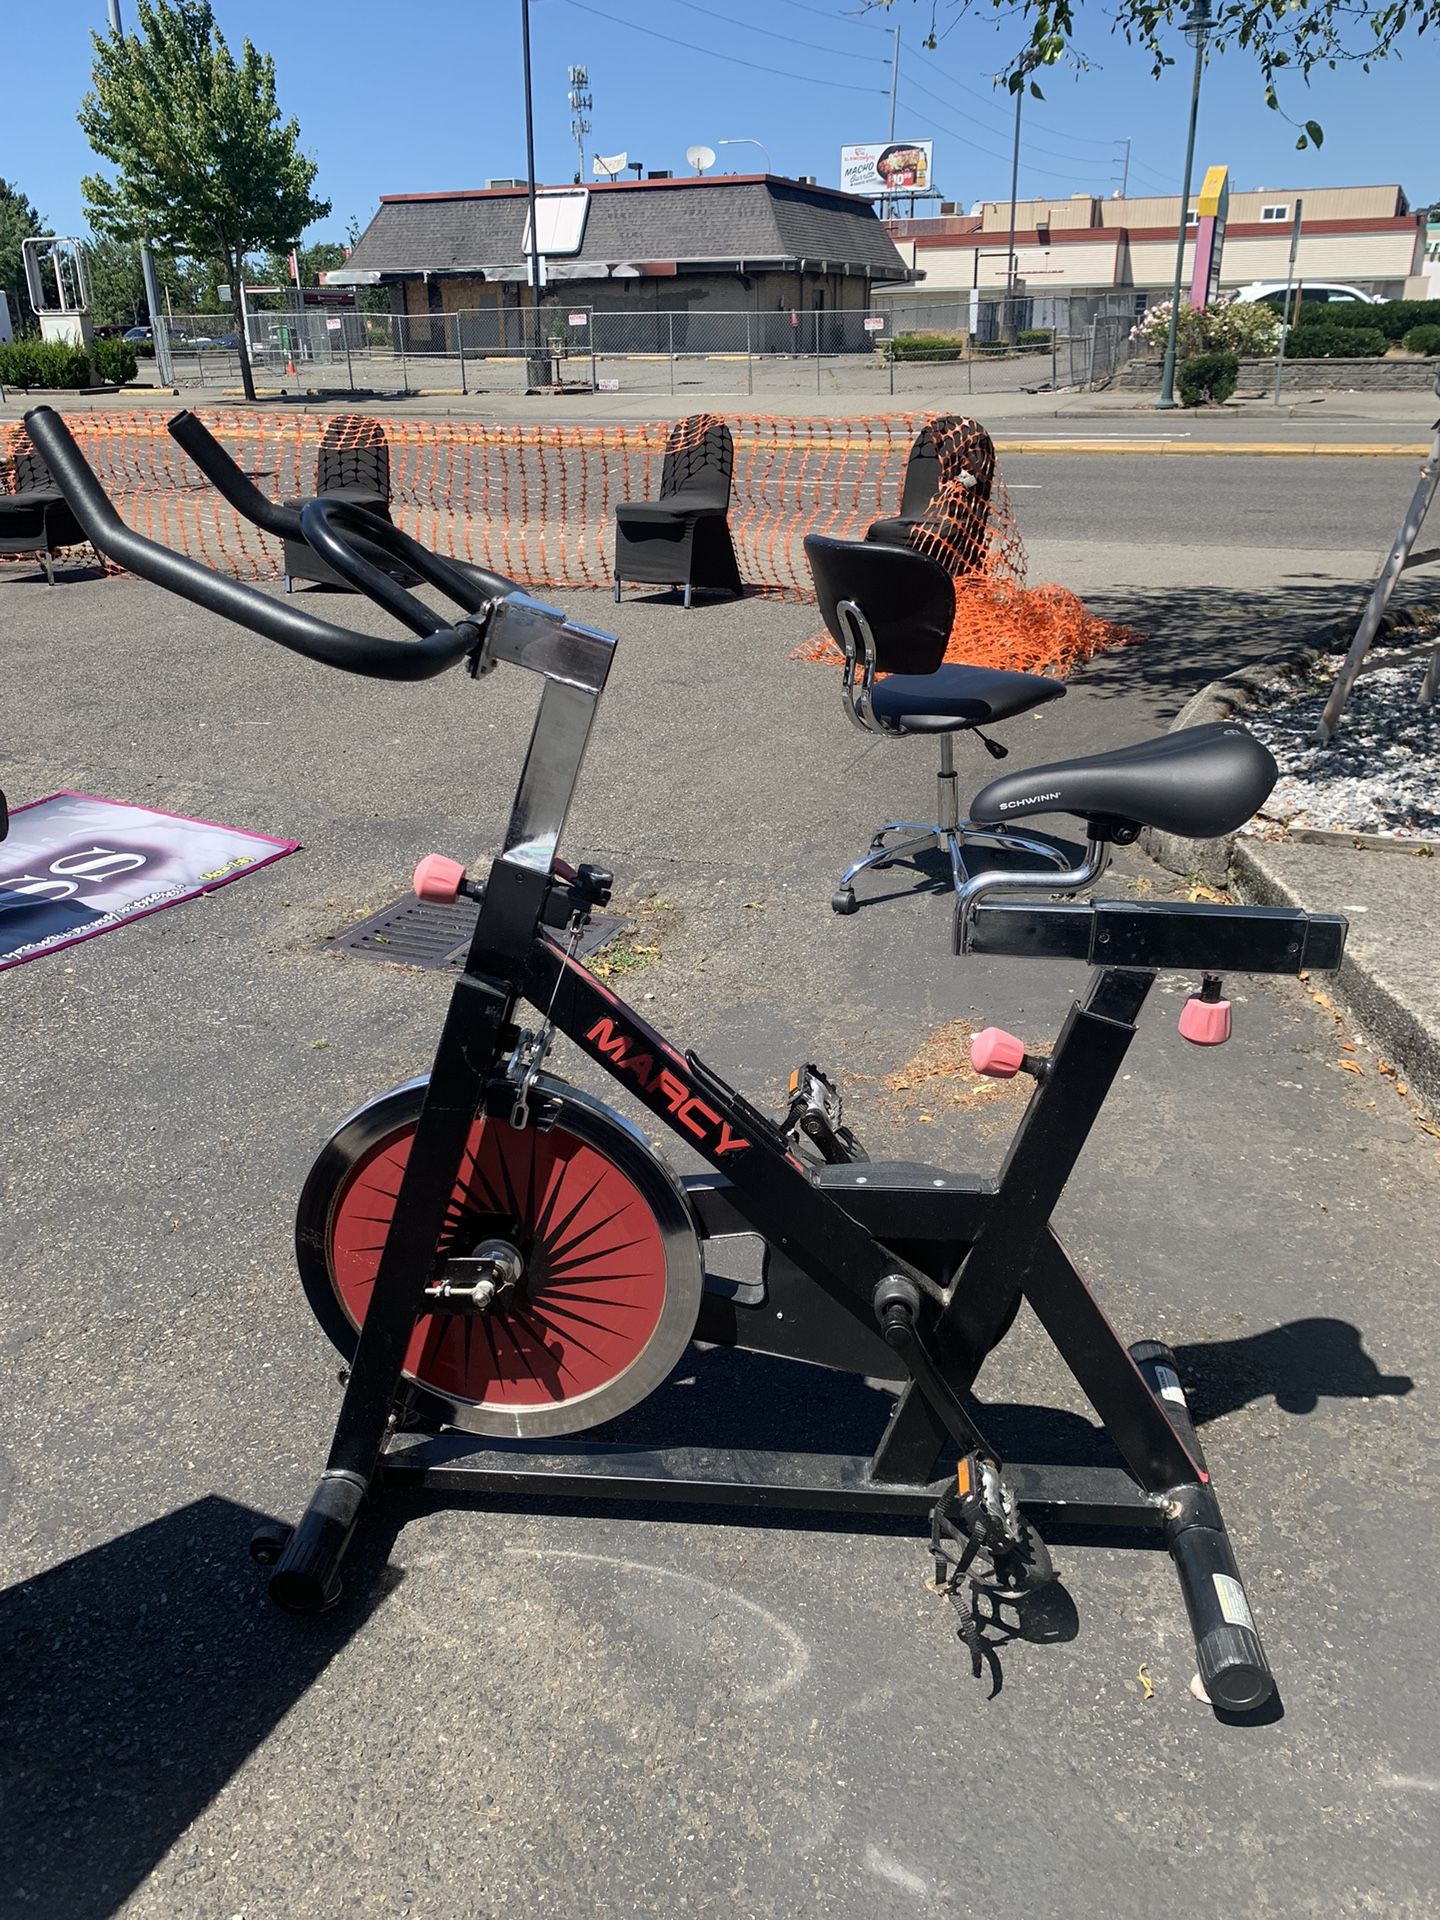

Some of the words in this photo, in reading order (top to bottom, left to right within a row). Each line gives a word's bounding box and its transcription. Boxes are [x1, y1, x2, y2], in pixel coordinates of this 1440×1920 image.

[844, 162, 875, 177] MACHO
[999, 791, 1061, 811] SCHWINN
[585, 1017, 751, 1156] MARCY
